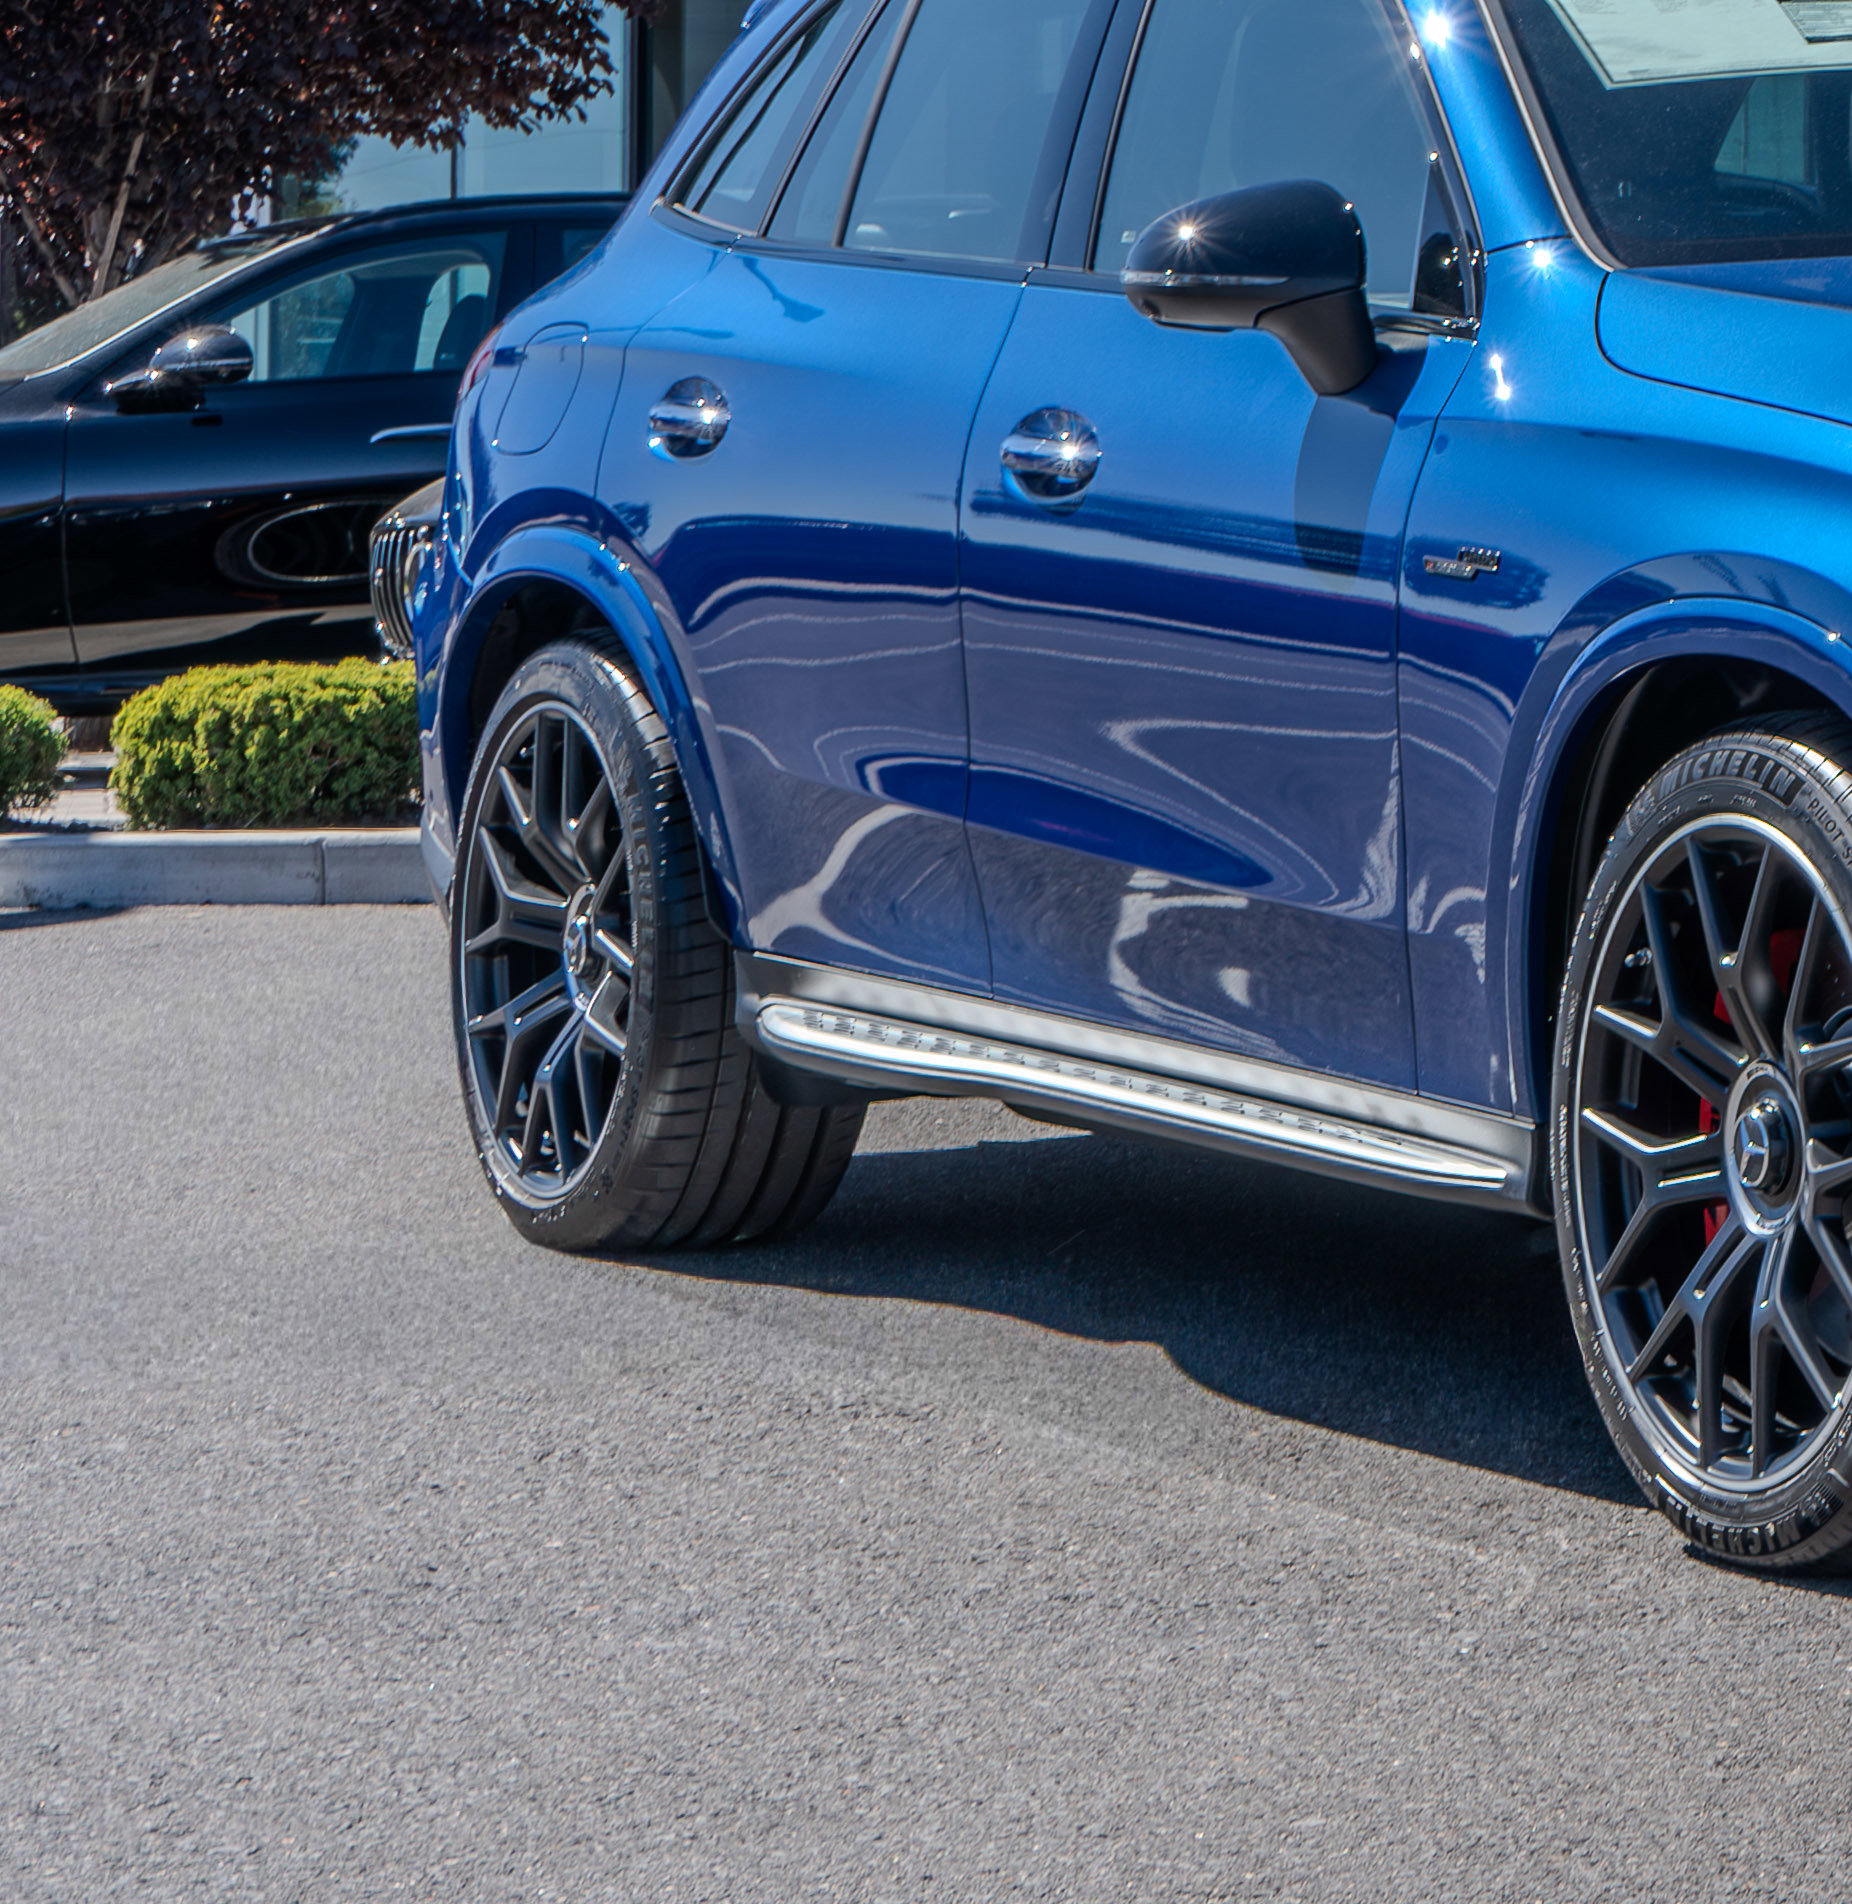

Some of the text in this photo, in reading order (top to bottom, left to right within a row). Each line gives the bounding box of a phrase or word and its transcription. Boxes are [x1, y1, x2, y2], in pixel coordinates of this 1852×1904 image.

[1660, 749, 1797, 800] MICHELIN
[1807, 798, 1844, 842] PILOT
[1665, 1496, 1802, 1556] MICHELIN
